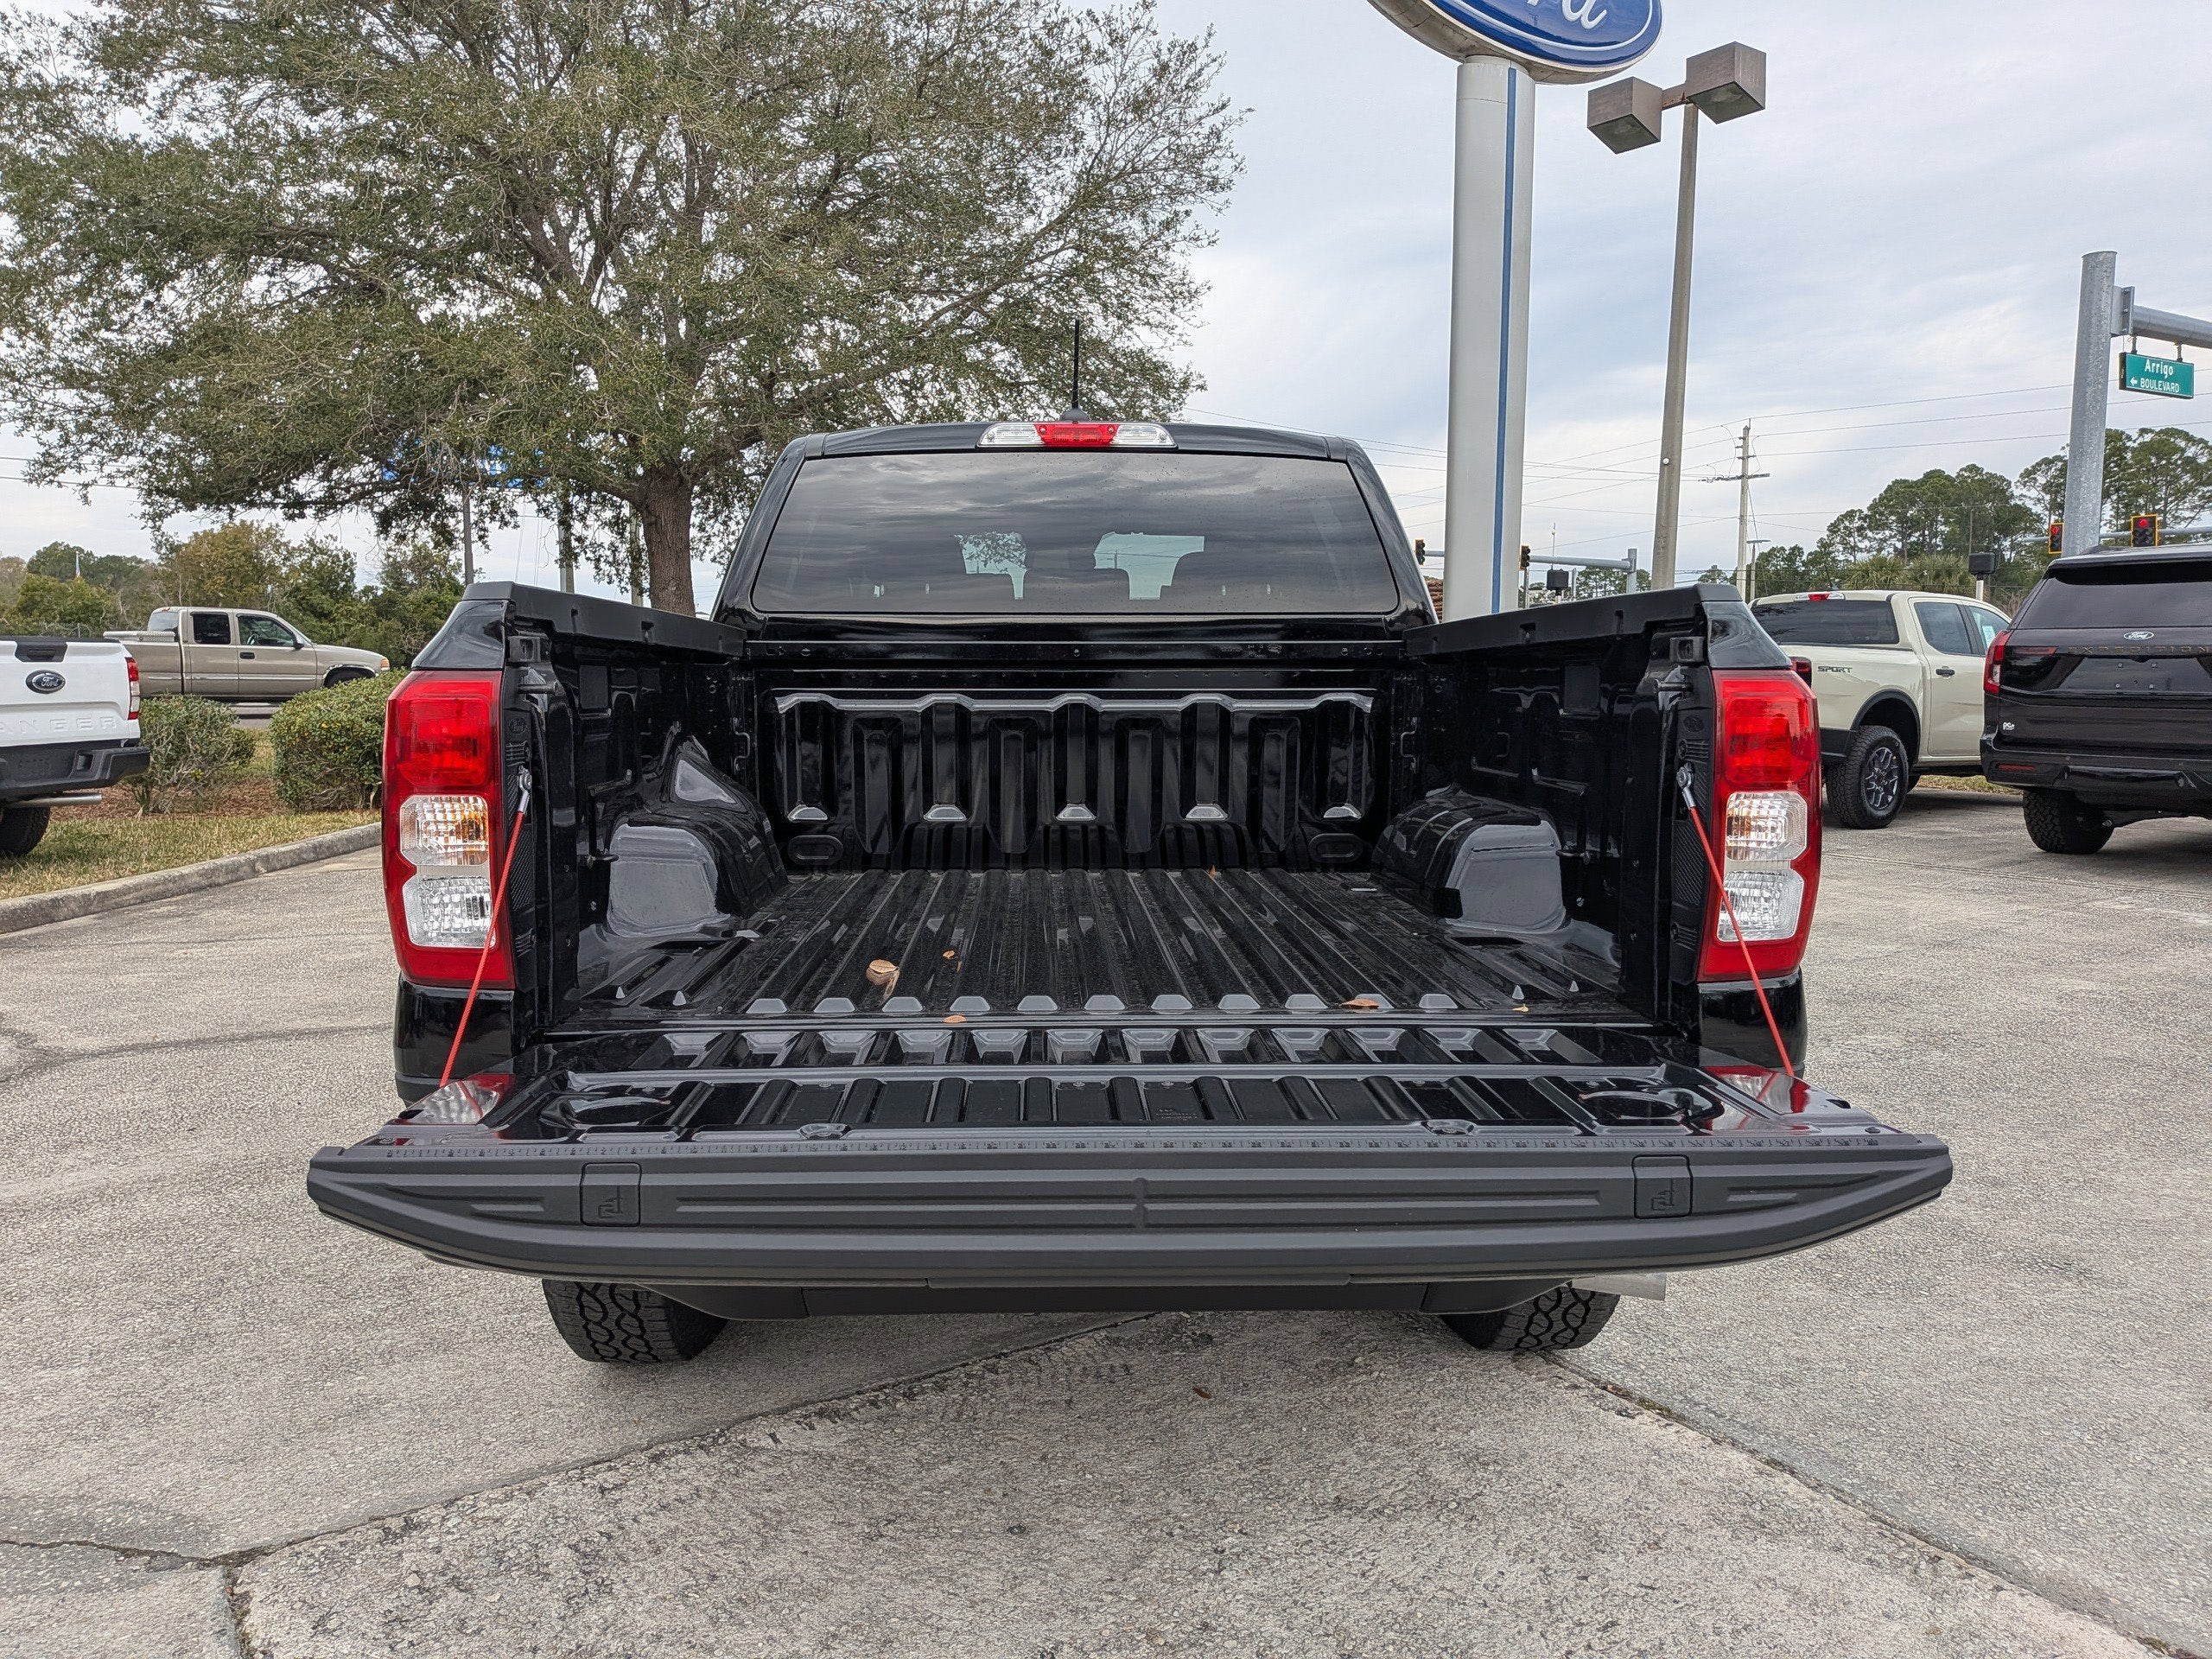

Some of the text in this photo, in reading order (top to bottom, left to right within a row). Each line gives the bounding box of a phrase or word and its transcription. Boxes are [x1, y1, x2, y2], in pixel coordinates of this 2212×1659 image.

[2144, 359, 2174, 378] Arrigo
[2139, 378, 2180, 393] BOULEVARD
[0, 715, 118, 734] ANGER
